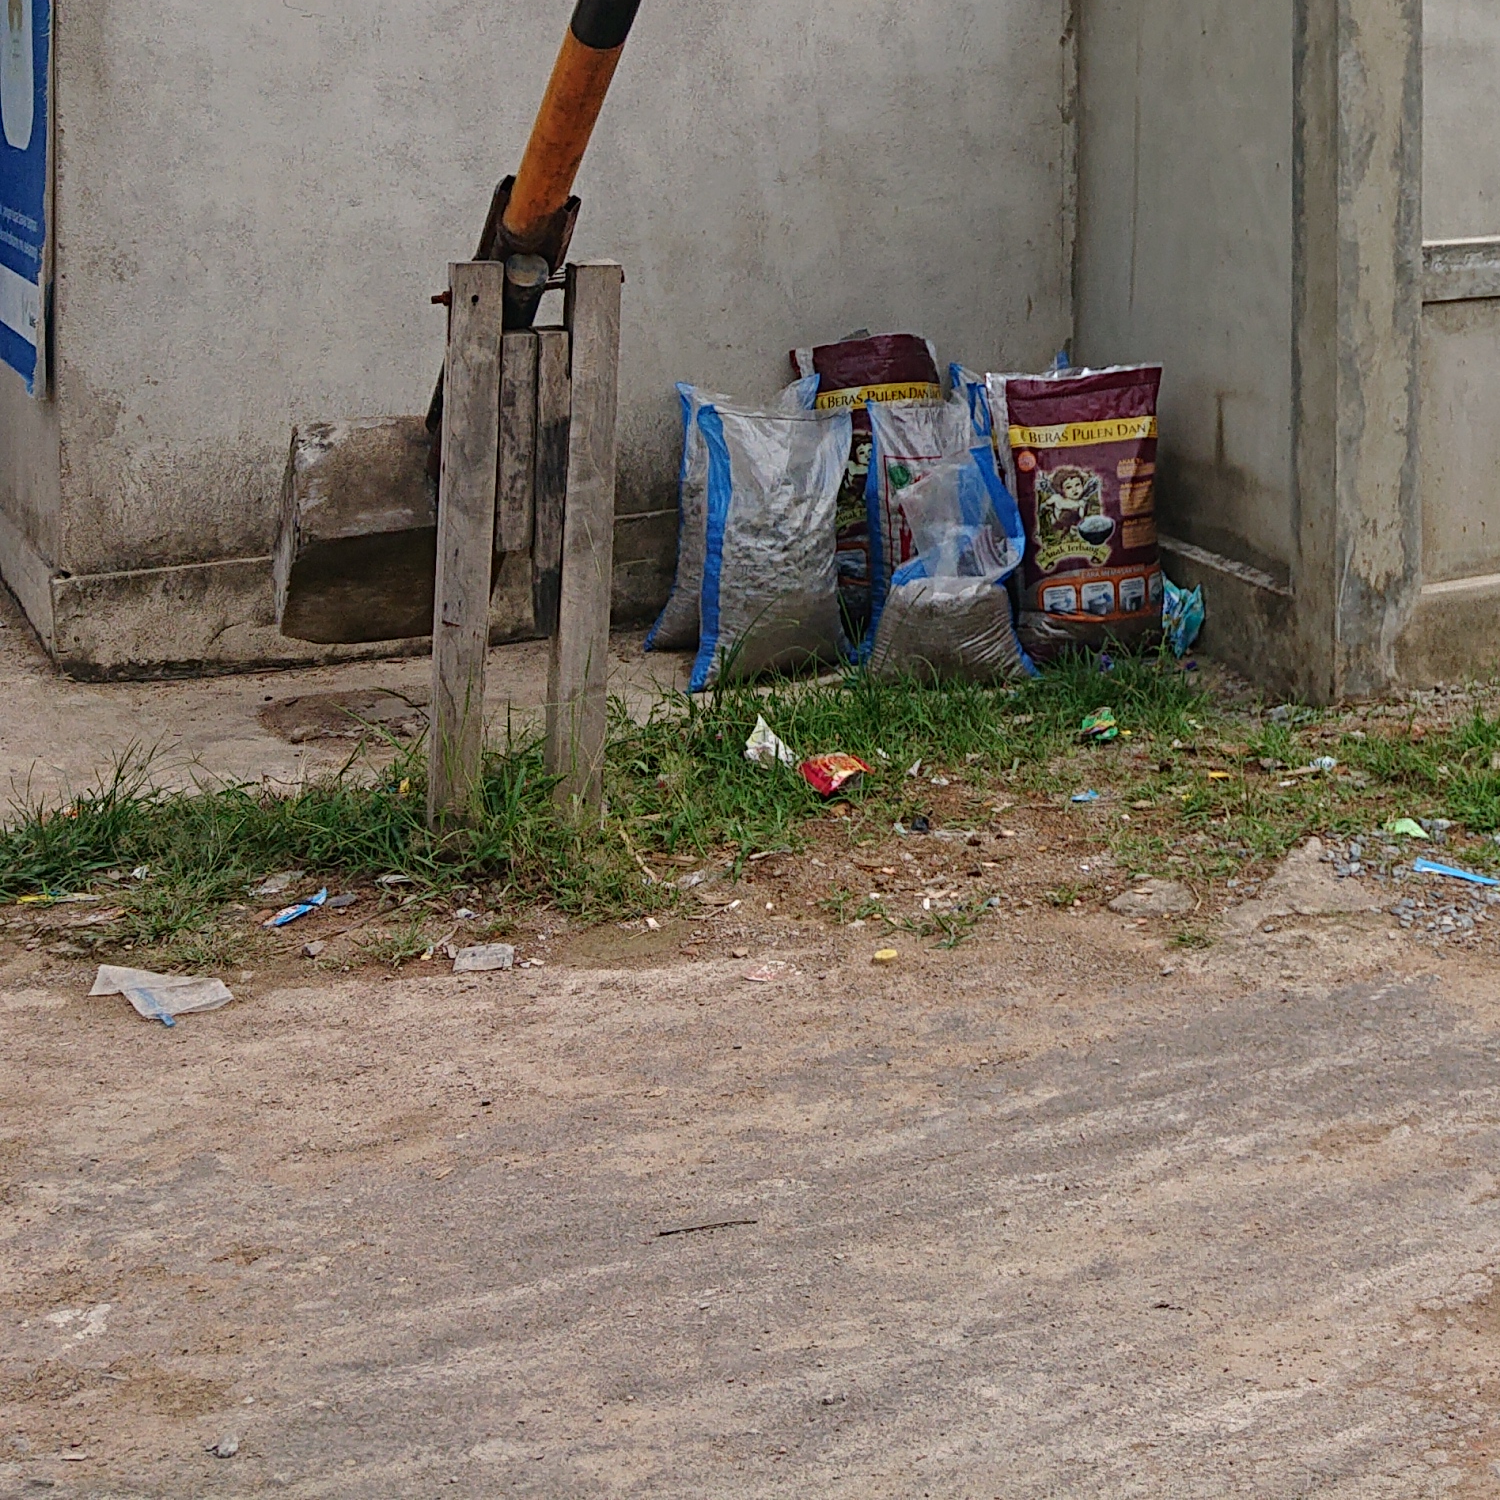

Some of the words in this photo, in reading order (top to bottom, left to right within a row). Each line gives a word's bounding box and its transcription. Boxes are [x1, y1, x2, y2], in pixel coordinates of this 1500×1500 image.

[827, 392, 864, 409] BERAS
[867, 389, 906, 402] PULEN
[908, 386, 929, 399] DAN
[1028, 430, 1068, 445] BERAS
[1072, 424, 1113, 442] PULEN
[1117, 422, 1146, 437] DAN
[1046, 545, 1064, 559] Anak
